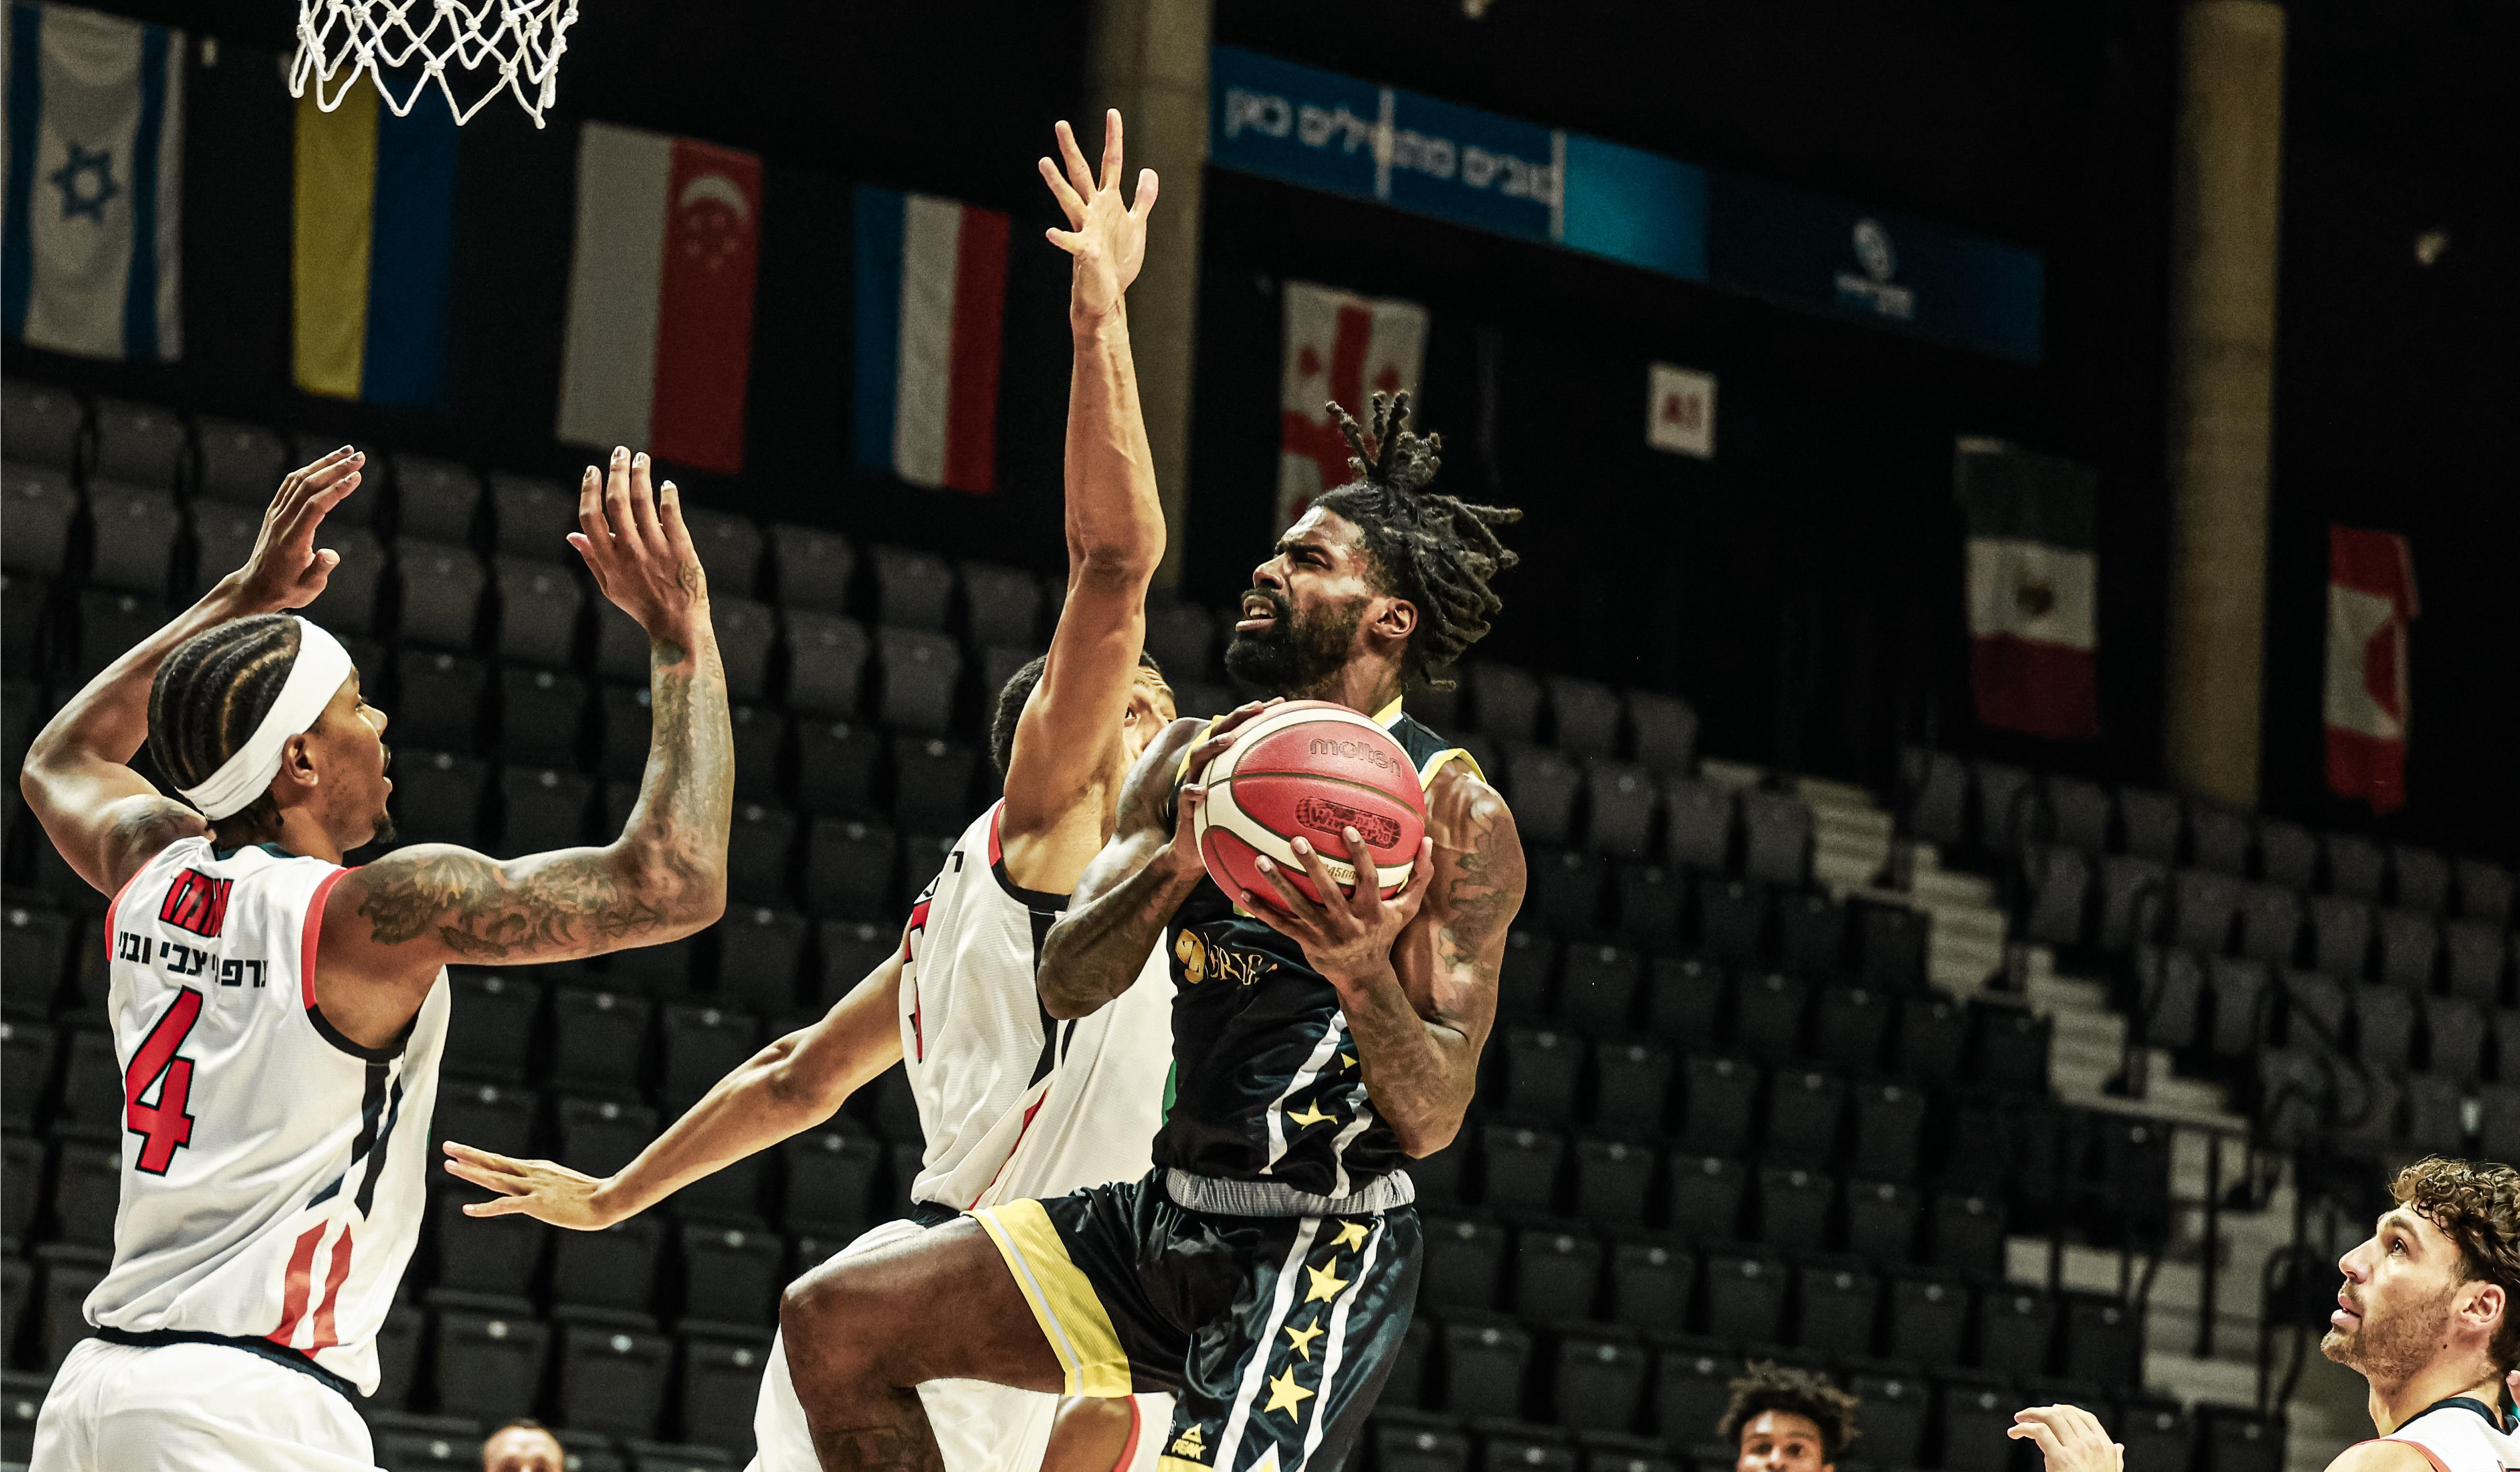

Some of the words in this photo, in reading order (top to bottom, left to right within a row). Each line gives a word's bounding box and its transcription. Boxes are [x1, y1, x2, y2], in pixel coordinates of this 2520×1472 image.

[1309, 738, 1401, 778] molten
[160, 941, 208, 977] צבי
[125, 985, 203, 1177] 4
[1171, 1438, 1207, 1460] PEAK
